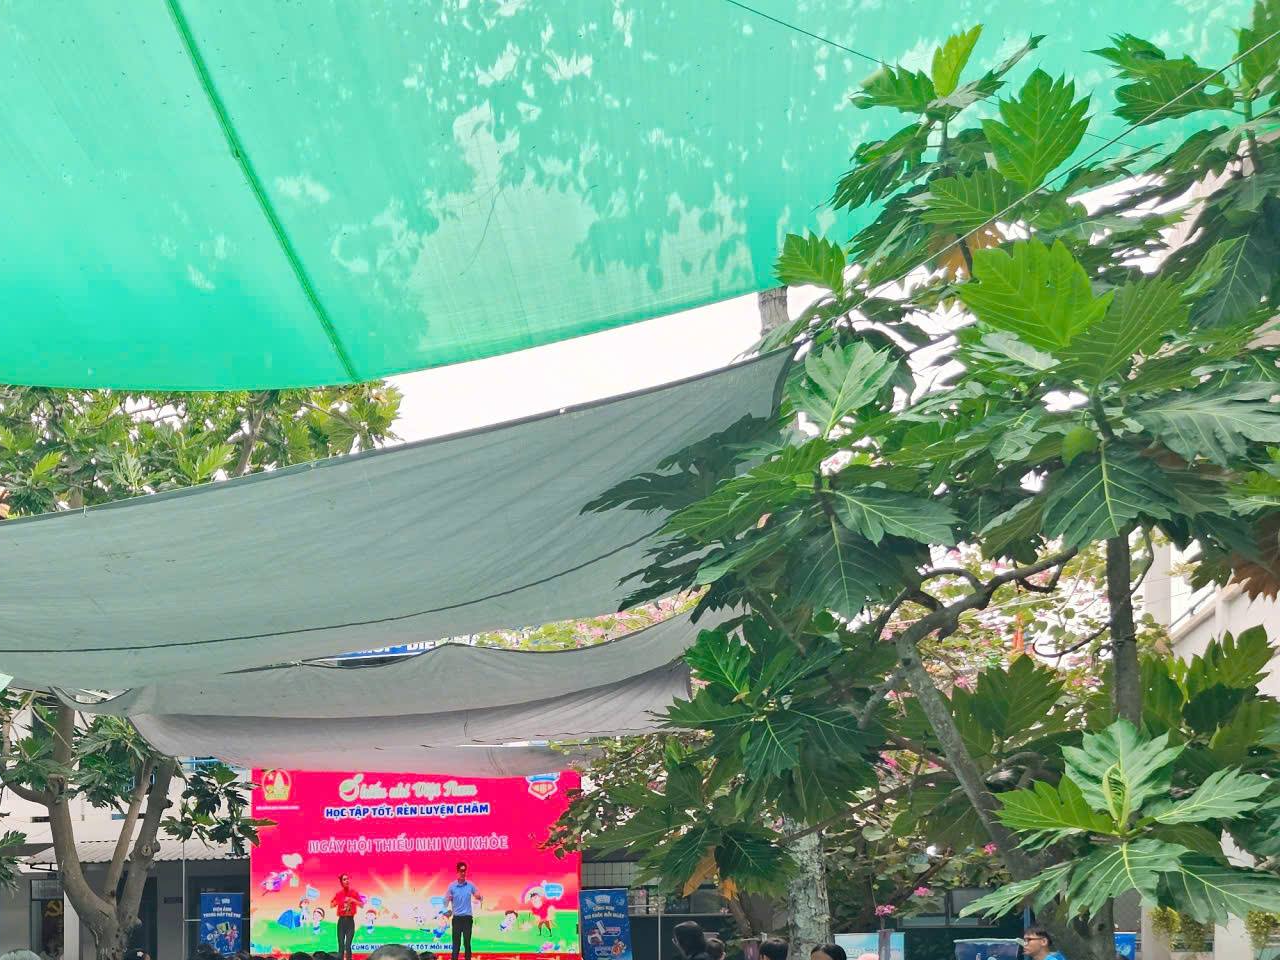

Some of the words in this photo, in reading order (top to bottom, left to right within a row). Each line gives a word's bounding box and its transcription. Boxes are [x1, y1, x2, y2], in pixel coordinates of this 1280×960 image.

[325, 808, 347, 820] HỌC
[350, 805, 370, 820] TẬP
[372, 804, 395, 817] TỐT,
[396, 802, 418, 816] RÈN
[420, 802, 454, 818] LUYỆN
[456, 801, 489, 814] CHĂM
[308, 836, 346, 854] NGÀY
[348, 835, 371, 855] HỘI
[373, 832, 415, 852] THIẾU
[416, 837, 441, 851] NHI
[442, 836, 468, 850] VUI
[469, 832, 509, 850] KHỎE
